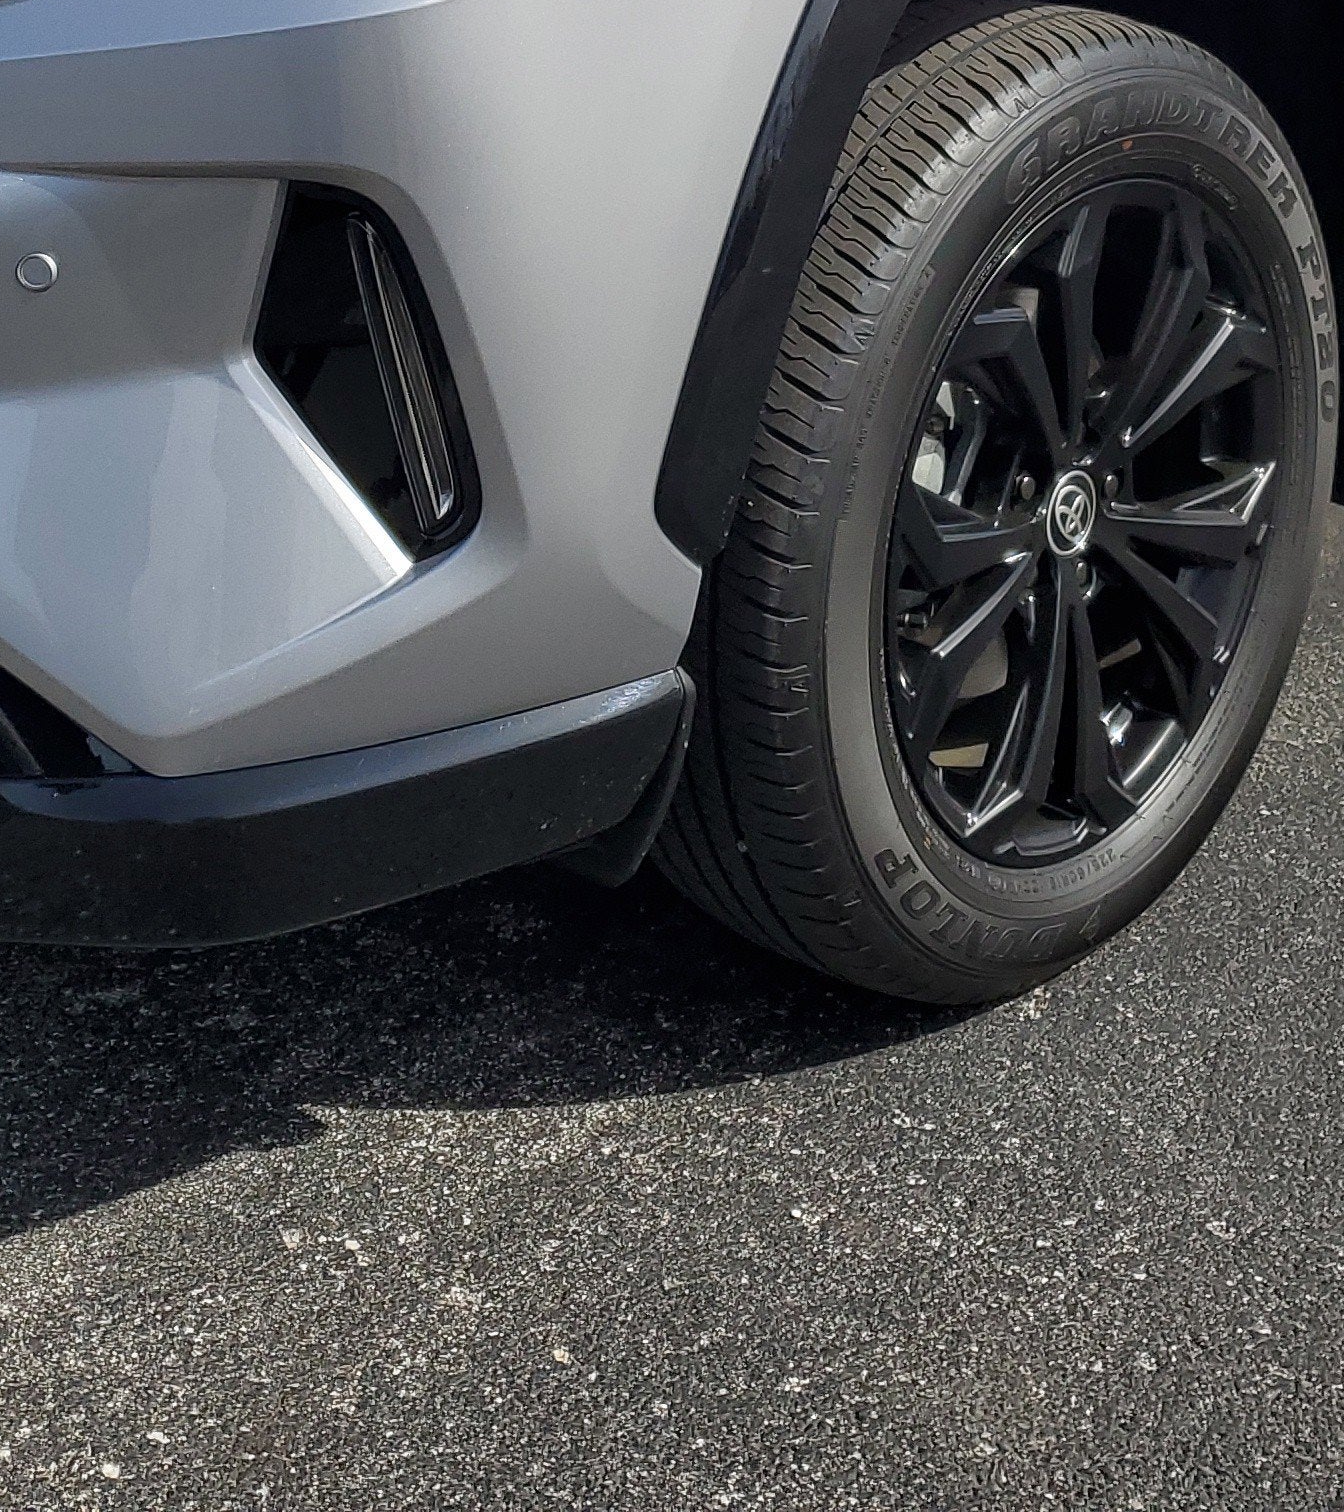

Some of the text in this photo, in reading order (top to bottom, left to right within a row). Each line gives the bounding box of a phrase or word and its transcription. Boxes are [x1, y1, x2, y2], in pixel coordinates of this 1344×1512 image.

[1005, 90, 1299, 220] GRANDTREK
[1295, 235, 1337, 424] PT20
[873, 848, 1068, 960] DUNLOP
